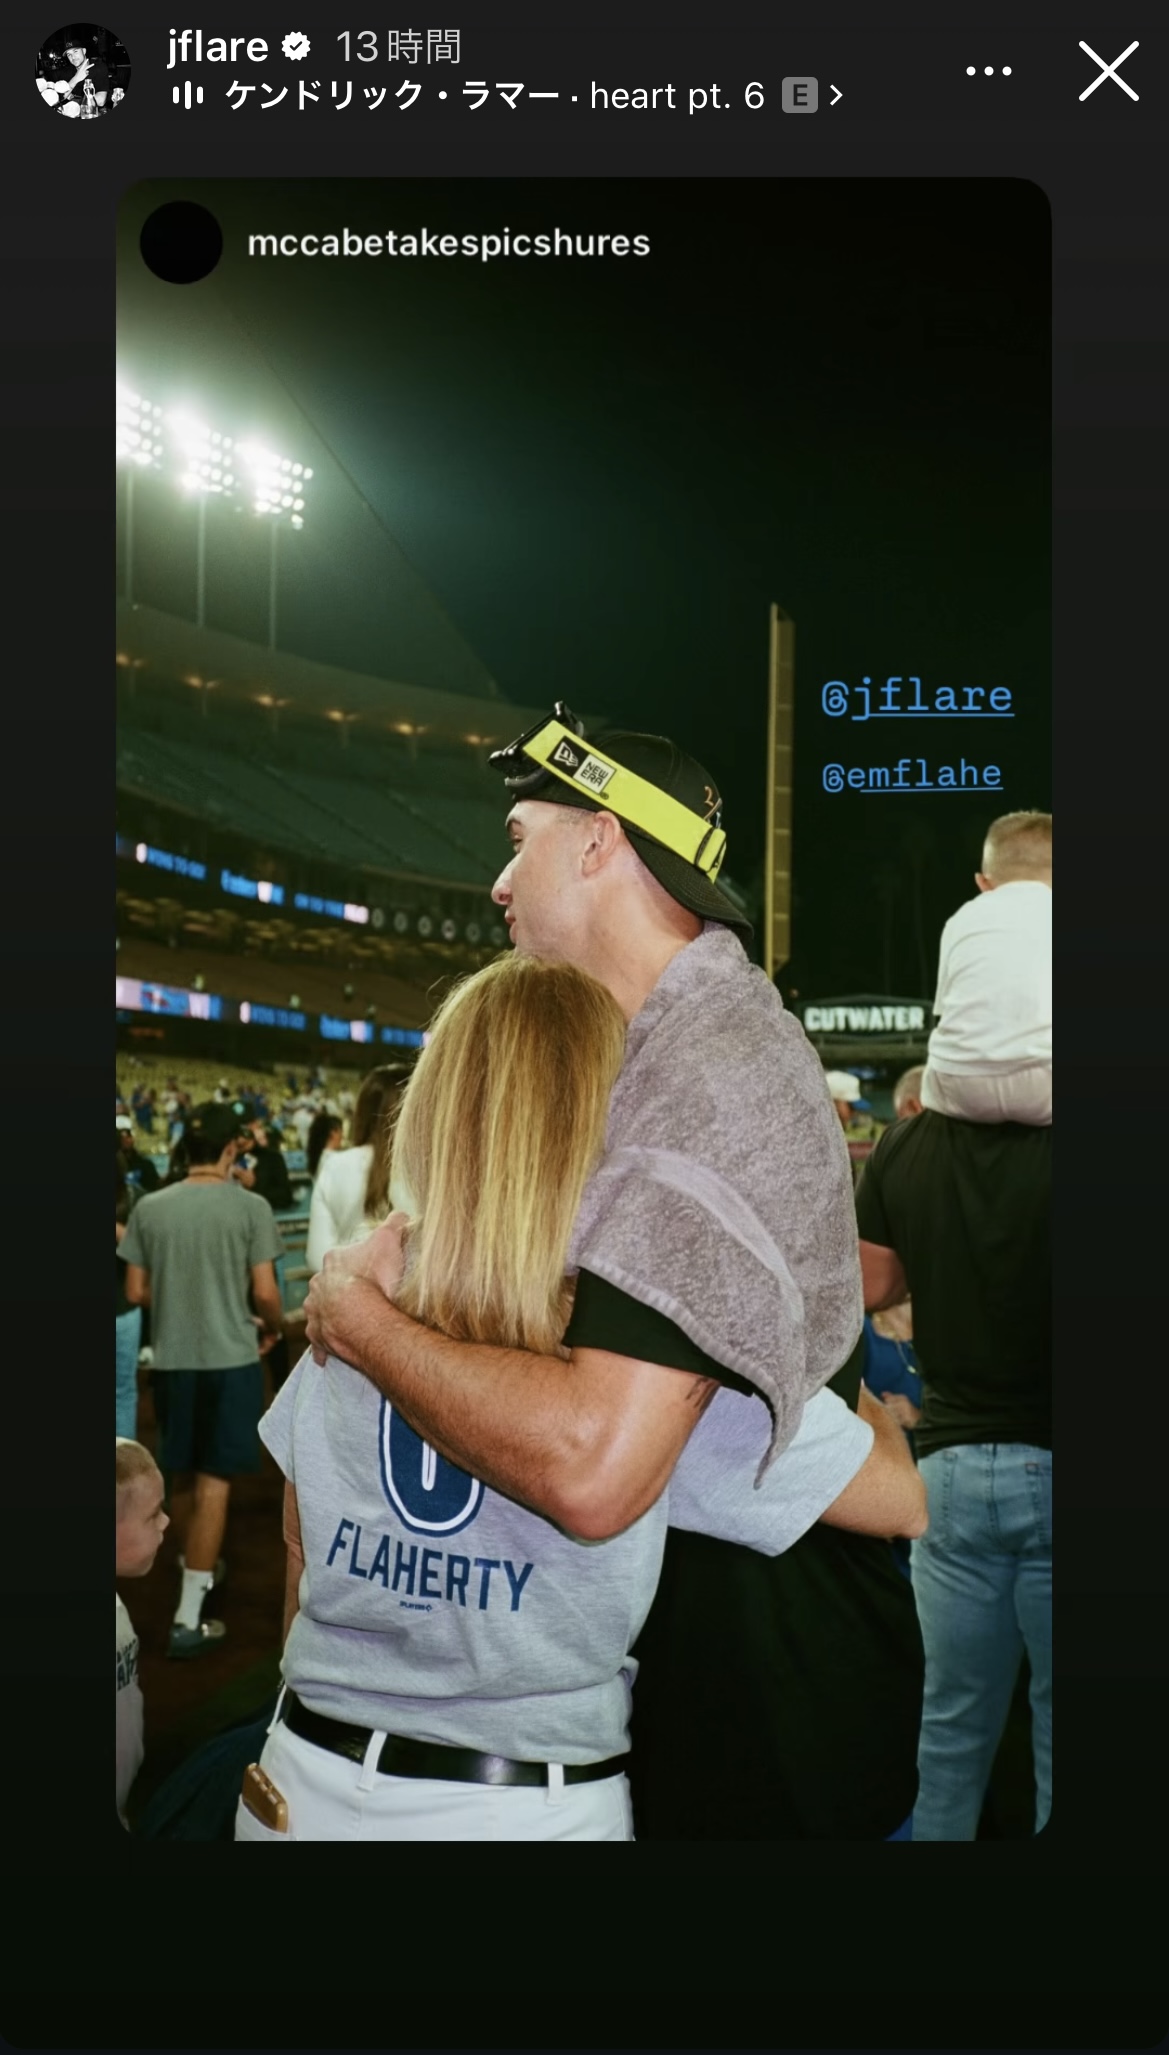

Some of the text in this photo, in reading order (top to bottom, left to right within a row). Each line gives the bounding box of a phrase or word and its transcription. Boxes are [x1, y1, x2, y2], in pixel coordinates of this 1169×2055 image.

[580, 769, 604, 787] ERA
[586, 761, 609, 779] NEW
[804, 1005, 925, 1032] CUTWATER
[325, 1518, 535, 1612] FLAHERTY
